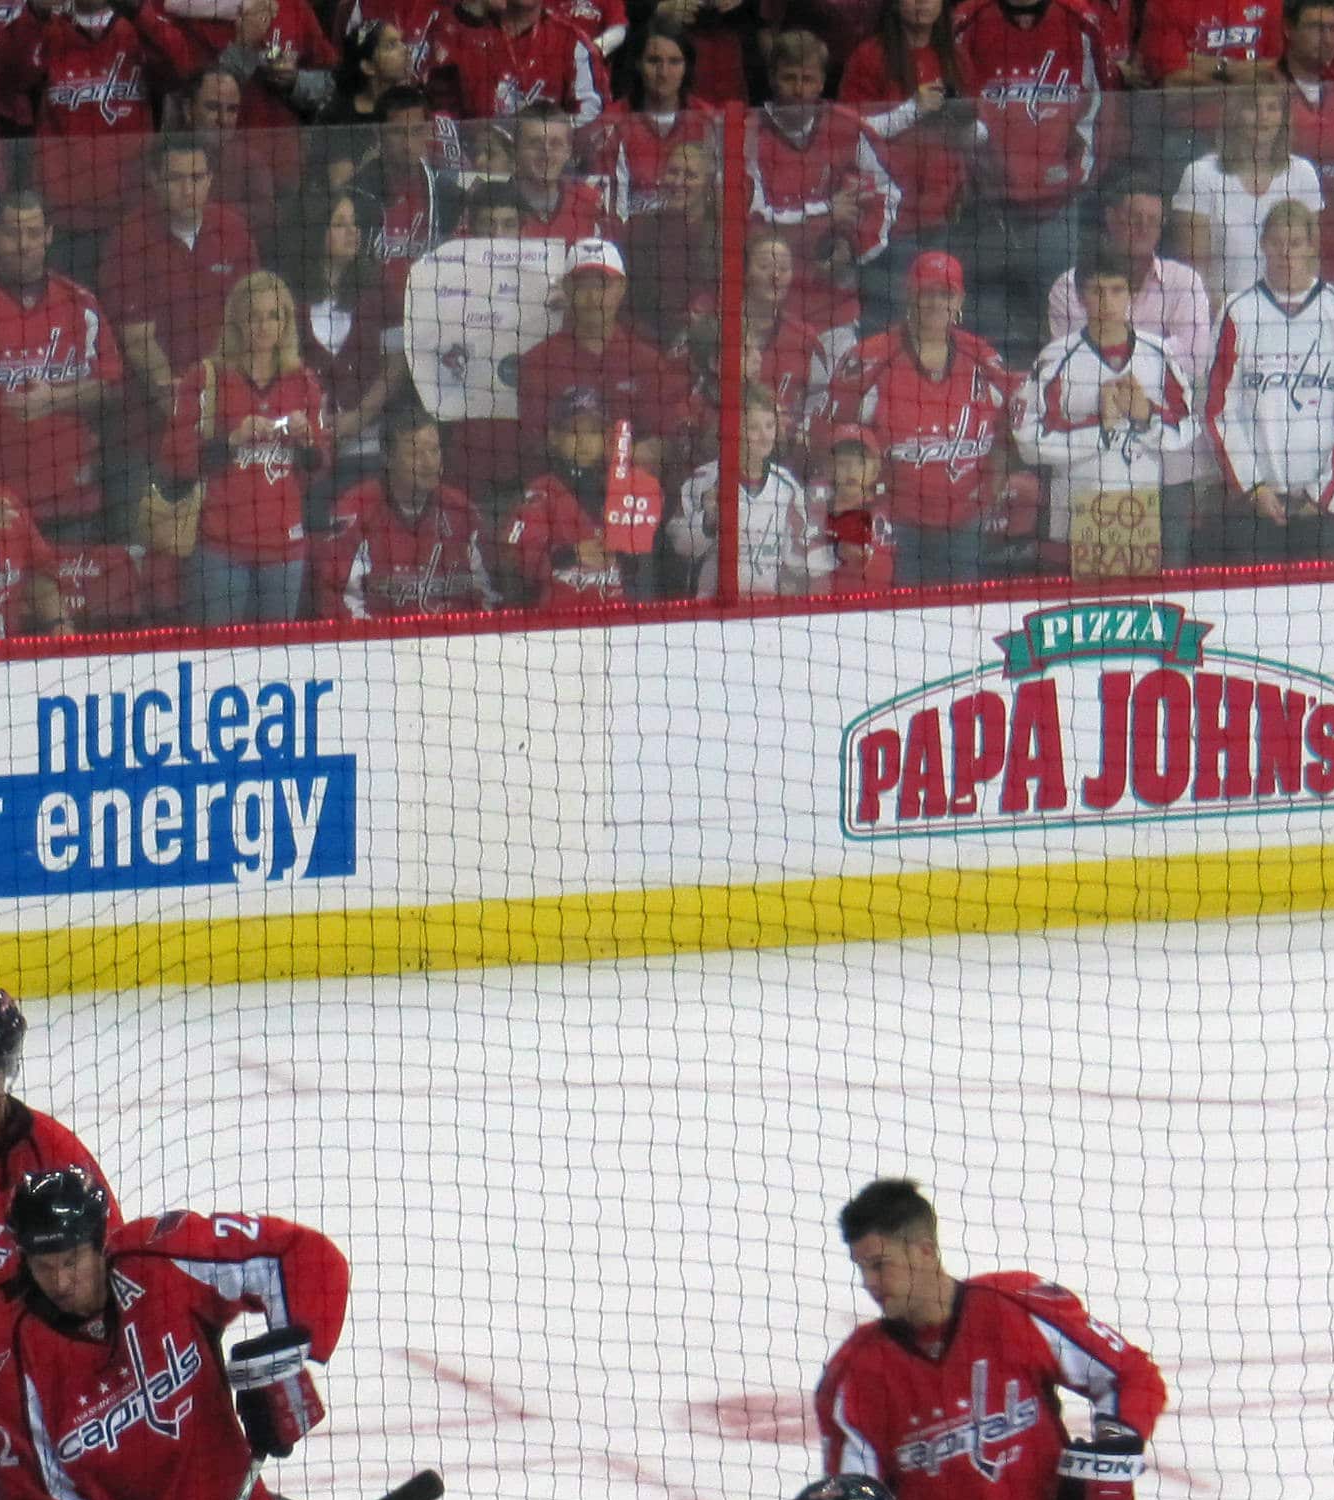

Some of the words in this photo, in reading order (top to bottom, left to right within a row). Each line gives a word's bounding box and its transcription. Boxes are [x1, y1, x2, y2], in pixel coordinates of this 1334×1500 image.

[623, 494, 648, 511] GO
[1041, 609, 1165, 650] PIZZA
[36, 661, 334, 777] nuclear
[855, 677, 1069, 824] PAPA
[36, 776, 329, 884] energy
[57, 1322, 202, 1463] capitals
